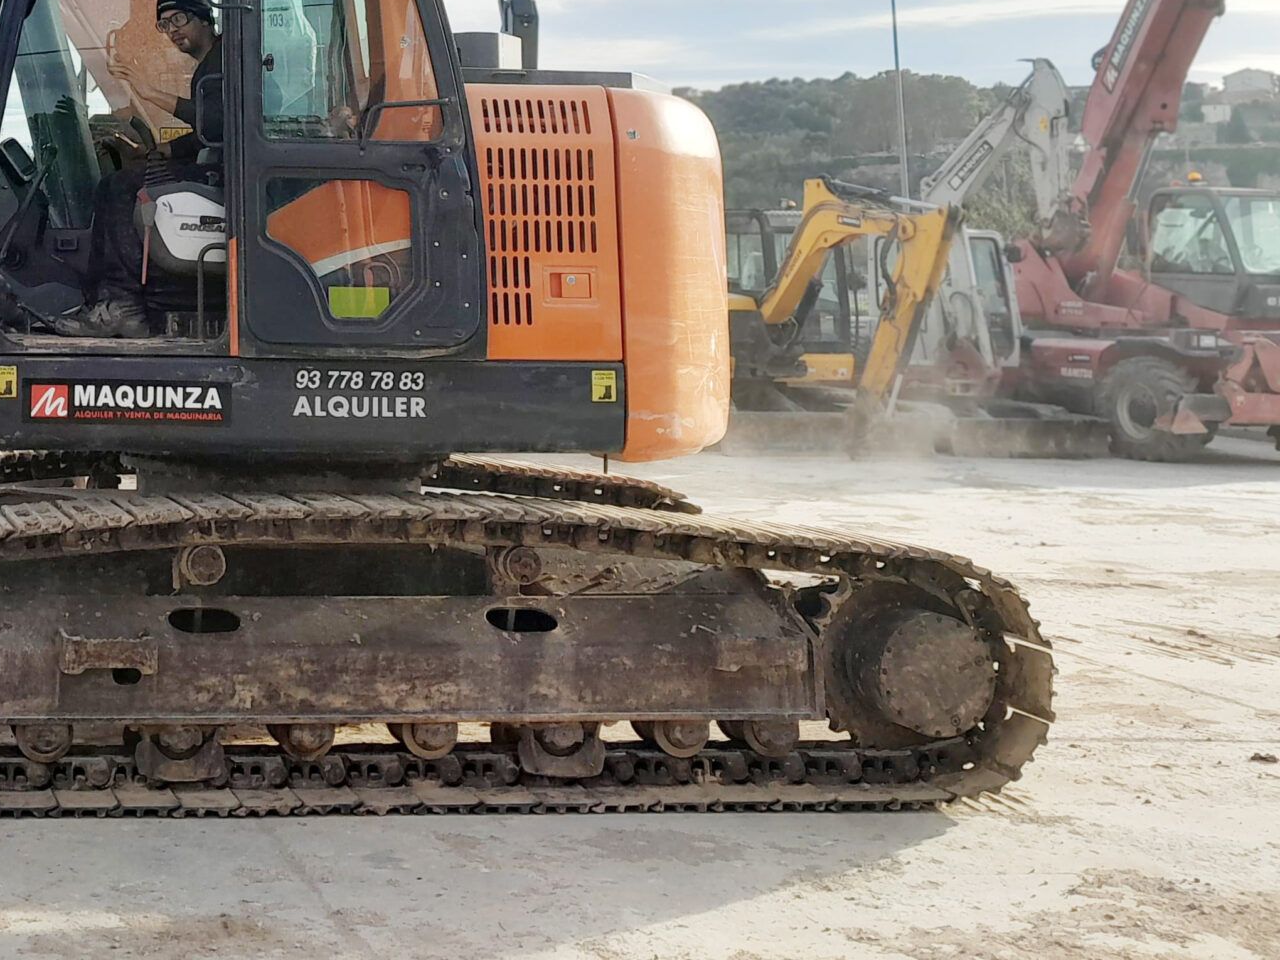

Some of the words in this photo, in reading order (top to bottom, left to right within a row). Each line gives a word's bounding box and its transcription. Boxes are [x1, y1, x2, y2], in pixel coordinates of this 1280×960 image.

[180, 223, 225, 232] DOOSA
[295, 370, 321, 389] 93
[327, 370, 364, 389] 778
[370, 371, 395, 390] 78
[399, 371, 425, 391] 83
[74, 384, 222, 409] MAQUINZA
[292, 395, 427, 418] ALQUILER
[74, 410, 114, 419] ALQUILER
[124, 411, 152, 419] VENTA
[153, 411, 164, 419] DE
[166, 411, 223, 421] MAQUINARIA
